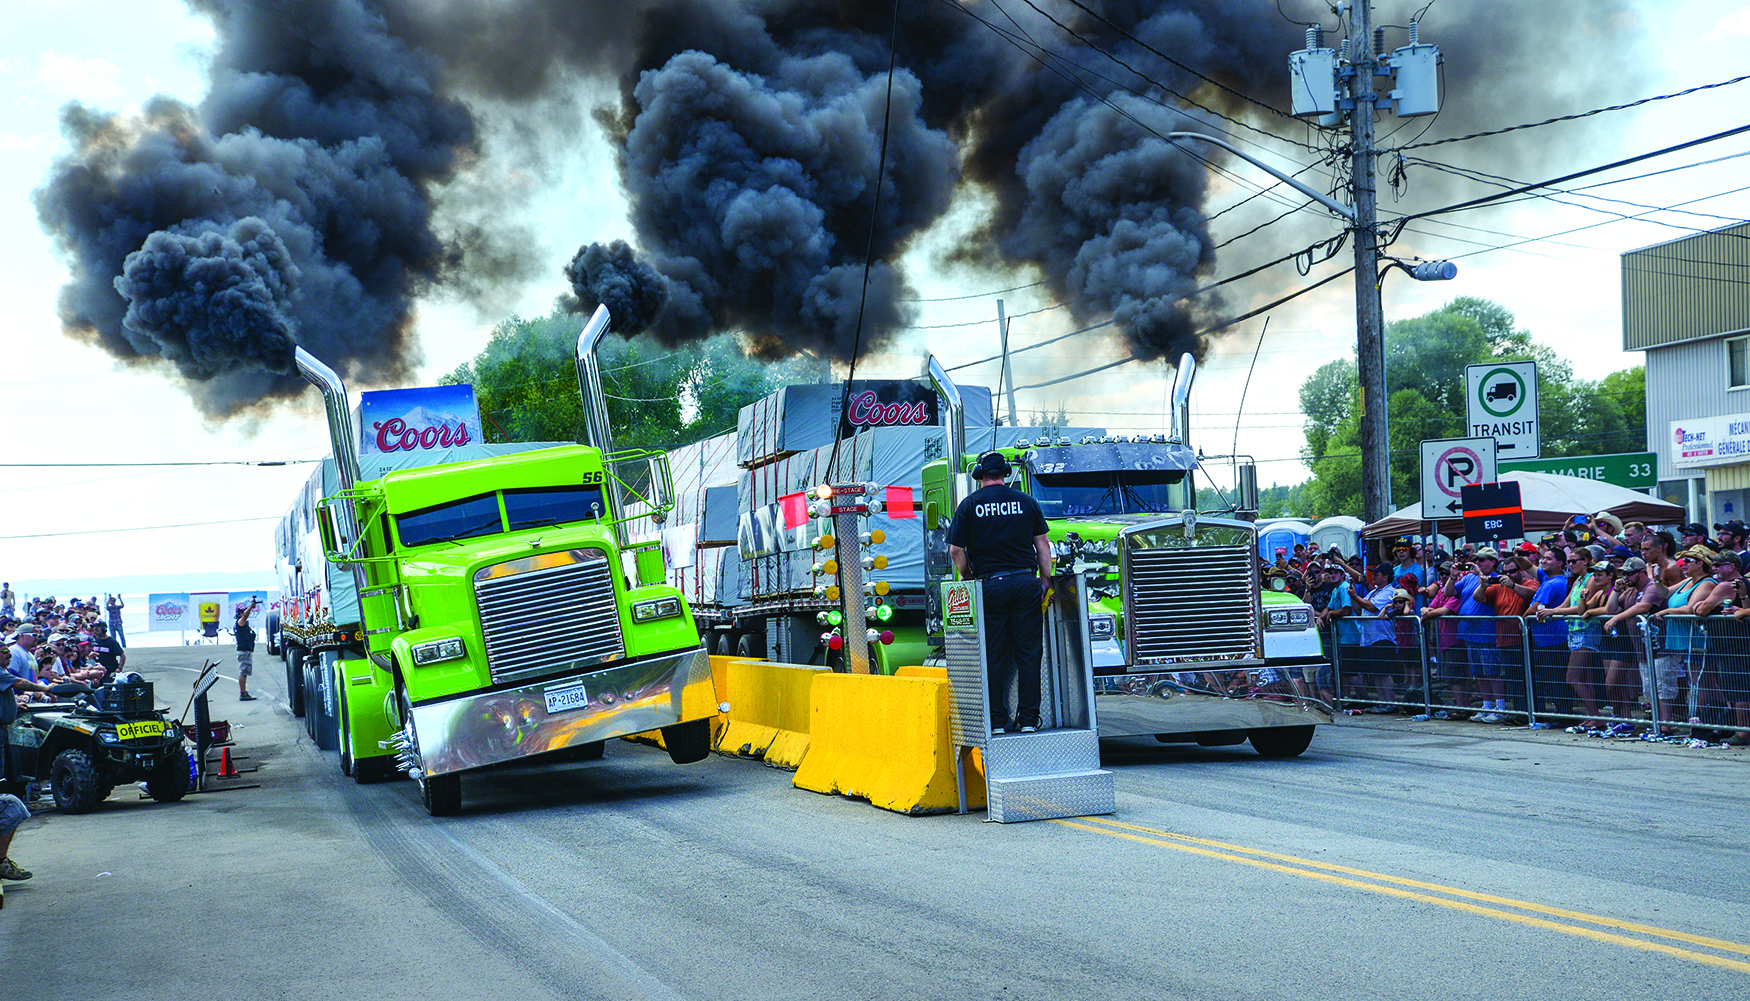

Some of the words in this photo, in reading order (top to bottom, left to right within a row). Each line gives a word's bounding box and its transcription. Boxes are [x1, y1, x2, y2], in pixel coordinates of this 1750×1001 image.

[849, 390, 930, 426] Coors
[373, 417, 471, 453] Coors
[1473, 420, 1534, 437] TRANSIT
[1718, 438, 1746, 455] GÉNÉRALE
[1043, 462, 1066, 474] 32
[1628, 463, 1651, 477] 33
[582, 471, 603, 484] 56
[975, 501, 1023, 518] OFFICIEL
[1484, 519, 1503, 530] EBC
[120, 724, 162, 737] OFFICIEL
